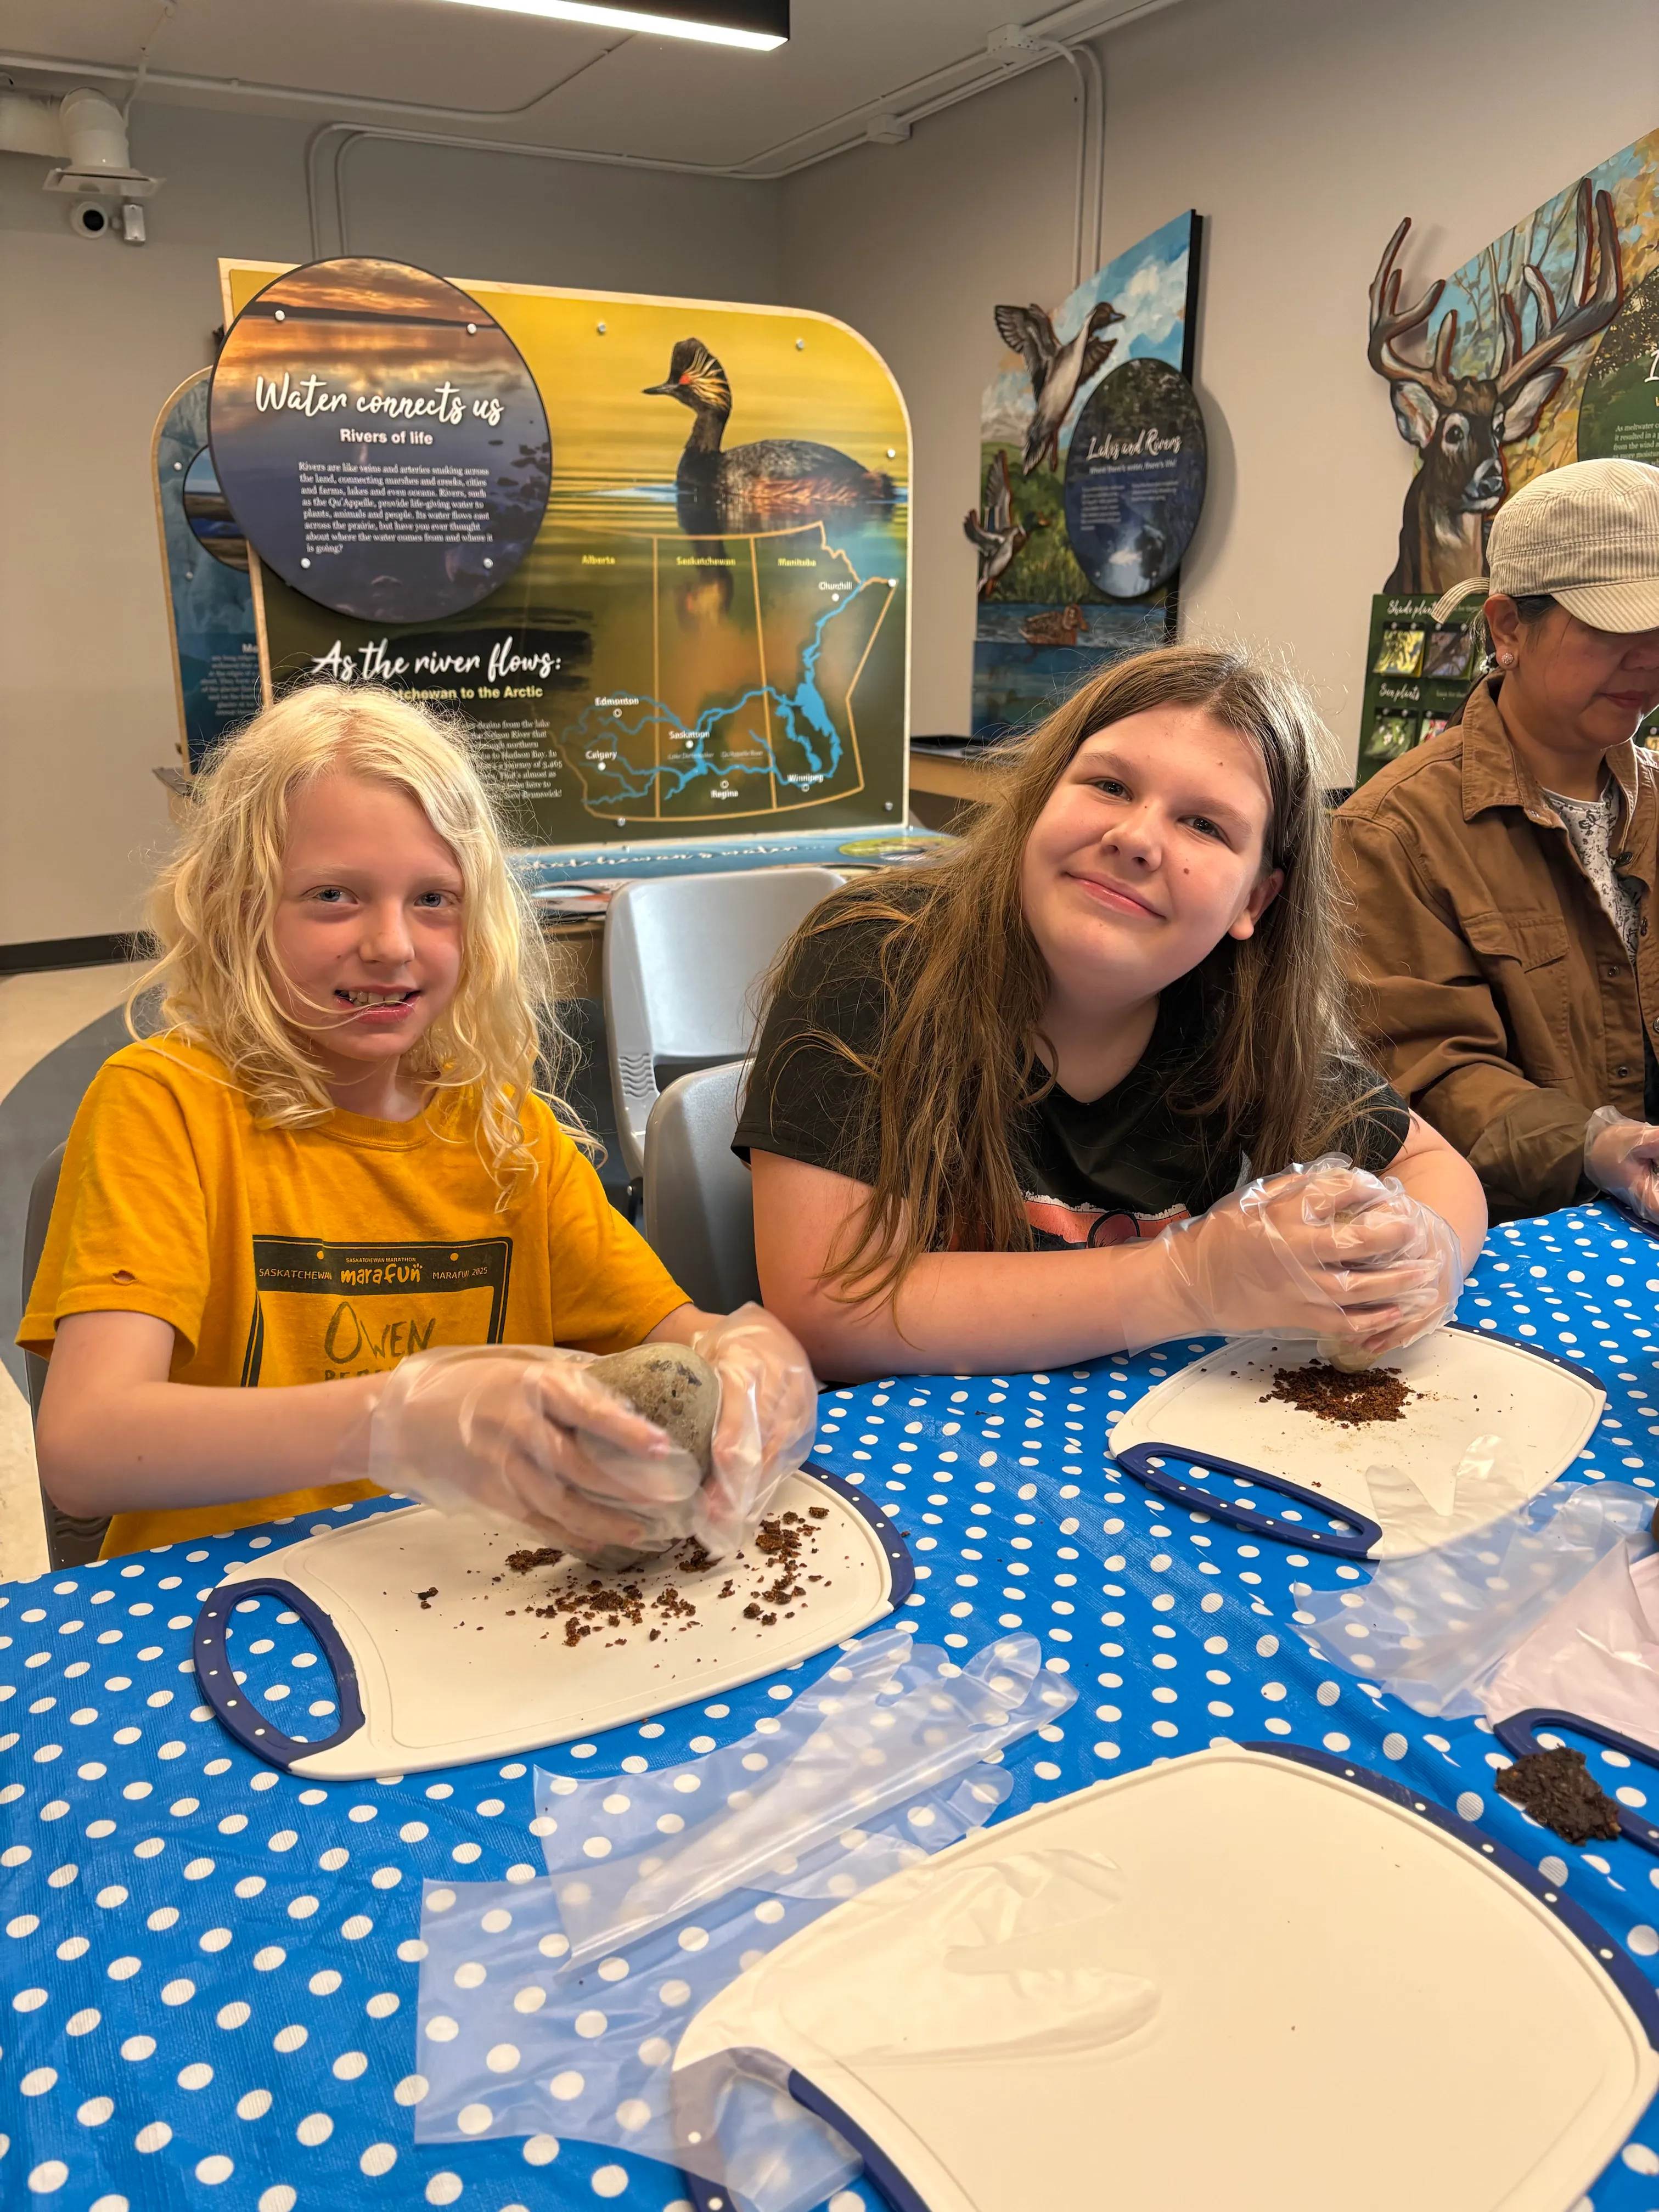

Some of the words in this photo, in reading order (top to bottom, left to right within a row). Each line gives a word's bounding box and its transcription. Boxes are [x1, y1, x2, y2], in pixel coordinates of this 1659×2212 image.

[256, 373, 348, 417] Water
[356, 381, 466, 425] connects
[473, 397, 504, 426] us
[1615, 425, 1623, 433] As
[1624, 422, 1655, 432] meltwater
[340, 428, 387, 443] Rivers
[391, 430, 407, 444] of
[410, 431, 434, 445] life
[1121, 429, 1146, 457] and
[1145, 427, 1183, 457] Rivers
[1620, 432, 1645, 442] resulted
[1646, 431, 1651, 440] in
[1613, 442, 1627, 452] from
[1629, 441, 1639, 451] the
[1639, 440, 1655, 449] wind
[299, 461, 326, 471] Rivers
[342, 462, 358, 472] like
[359, 464, 381, 473] veins
[382, 463, 398, 474] and
[400, 464, 431, 475] arteries
[431, 465, 463, 477] snaking
[299, 473, 314, 483] the
[314, 473, 337, 484] land,
[338, 475, 384, 487] connecting
[384, 475, 419, 486] marshes
[420, 476, 436, 486] and
[436, 476, 465, 487] creeks,
[465, 477, 487, 487] cities
[301, 485, 318, 495] and
[318, 485, 346, 496] farms,
[346, 486, 369, 496] lakes
[369, 486, 386, 496] and
[407, 489, 438, 497] oceans.
[438, 487, 466, 499] Rivers,
[467, 488, 487, 498] such
[301, 498, 312, 506] as
[313, 497, 327, 506] the
[328, 497, 377, 509] Qu'Appelle,
[378, 498, 409, 510] provide
[409, 498, 451, 511] life-giving
[451, 500, 473, 509] water
[475, 500, 485, 509] to
[303, 508, 333, 520] plants,
[333, 509, 367, 519] animals
[367, 509, 384, 519] and
[384, 510, 414, 521] people.
[415, 510, 428, 520] Its
[428, 511, 450, 520] water
[451, 510, 473, 520] flows
[473, 511, 490, 520] east
[304, 522, 331, 530] across
[332, 520, 347, 530] the
[347, 520, 378, 532] prairie,
[379, 521, 393, 531] but
[394, 520, 414, 531] have
[414, 523, 430, 532] you
[430, 523, 448, 531] ever
[449, 521, 481, 533] thought
[305, 531, 329, 541] about
[330, 531, 357, 542] where
[357, 532, 372, 542] the
[373, 533, 396, 542] water
[397, 533, 423, 542] comes
[424, 532, 444, 542] from
[444, 532, 460, 542] and
[461, 532, 486, 542] where
[486, 533, 493, 542] it
[306, 542, 314, 553] is
[315, 543, 344, 555] going?
[581, 555, 616, 566] Alberta
[676, 556, 736, 567] Saskatchewan
[778, 557, 817, 567] Manitoba
[818, 581, 853, 591] Churchill
[1387, 599, 1412, 616] Shade
[1411, 600, 1436, 619] plant
[311, 639, 356, 682] As
[357, 638, 409, 680] the
[414, 650, 481, 675] river
[487, 635, 562, 683] flows:
[398, 688, 457, 701] tchewan
[460, 687, 475, 699] to
[478, 686, 500, 699] the
[503, 685, 543, 698] Arctic
[1379, 682, 1394, 698] Sun
[1393, 683, 1420, 702] plants
[594, 696, 639, 706] Edmonton
[477, 719, 502, 729] drains
[502, 720, 520, 729] from
[521, 719, 534, 728] the
[534, 719, 550, 728] lake
[485, 730, 510, 739] Nelson
[511, 730, 530, 739] River
[531, 730, 547, 738] that
[668, 730, 710, 739] Saskatoon
[506, 739, 538, 750] northern
[501, 750, 531, 760] Hudson
[531, 750, 548, 759] Bay.
[548, 750, 557, 758] In
[585, 750, 617, 761] Calgary
[504, 761, 532, 770] journey
[532, 761, 541, 769] of
[523, 770, 547, 779] almost
[787, 773, 824, 784] Winnipeg
[525, 780, 542, 789] here
[542, 780, 552, 789] to
[522, 789, 562, 800] Brunswick!
[710, 789, 739, 799] Regina
[259, 1268, 332, 1280] SASKATCHEWAN
[432, 1270, 469, 1279] MARAFUN
[472, 1267, 488, 1276] 2025
